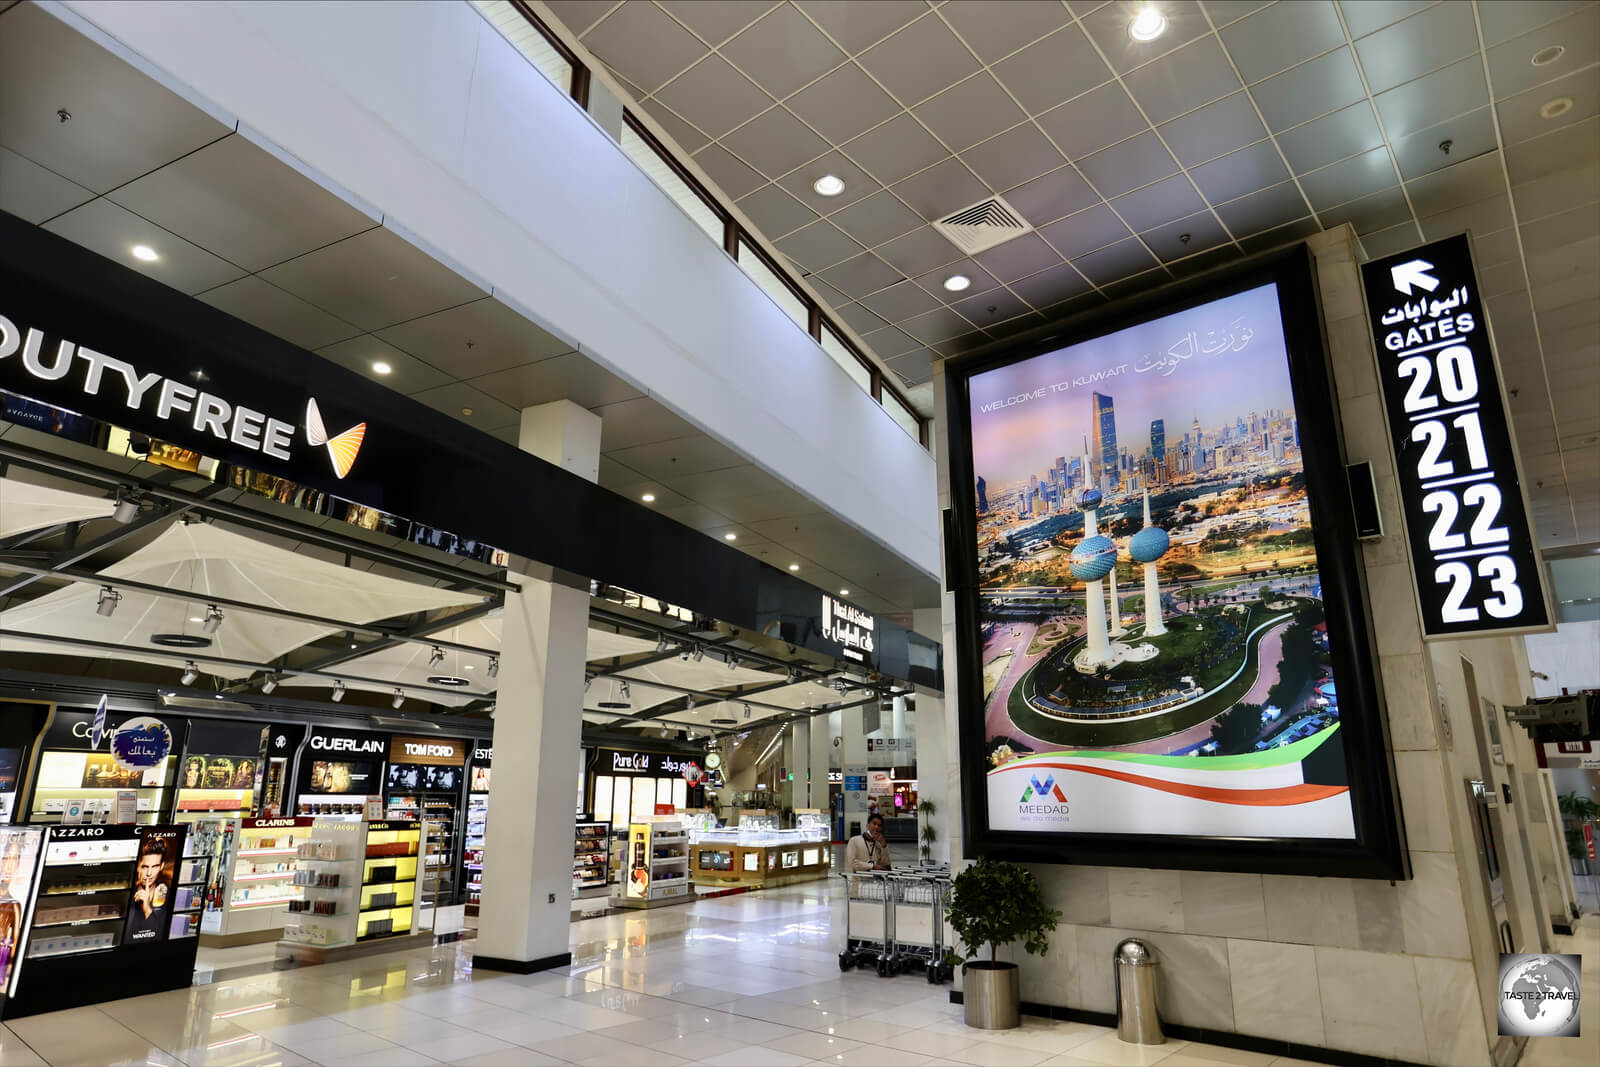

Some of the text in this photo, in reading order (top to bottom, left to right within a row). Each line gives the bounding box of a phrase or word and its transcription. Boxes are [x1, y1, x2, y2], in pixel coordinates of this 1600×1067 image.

[1381, 285, 1468, 325] البوابات
[1385, 313, 1475, 351] GATES
[1134, 331, 1199, 377] الكويت
[980, 364, 1128, 413] WELCOME TO KUWAIT
[1398, 345, 1479, 413] 20
[1411, 411, 1489, 479] 21
[1422, 482, 1510, 551] 22
[1434, 555, 1524, 623] 23
[310, 736, 385, 753] GUERLAIN
[404, 743, 454, 757] TOM FORD
[613, 752, 649, 771] Pure Gold
[255, 819, 295, 827] CLARINS
[1019, 805, 1070, 815] MEEDAD
[132, 931, 155, 939] WANTED
